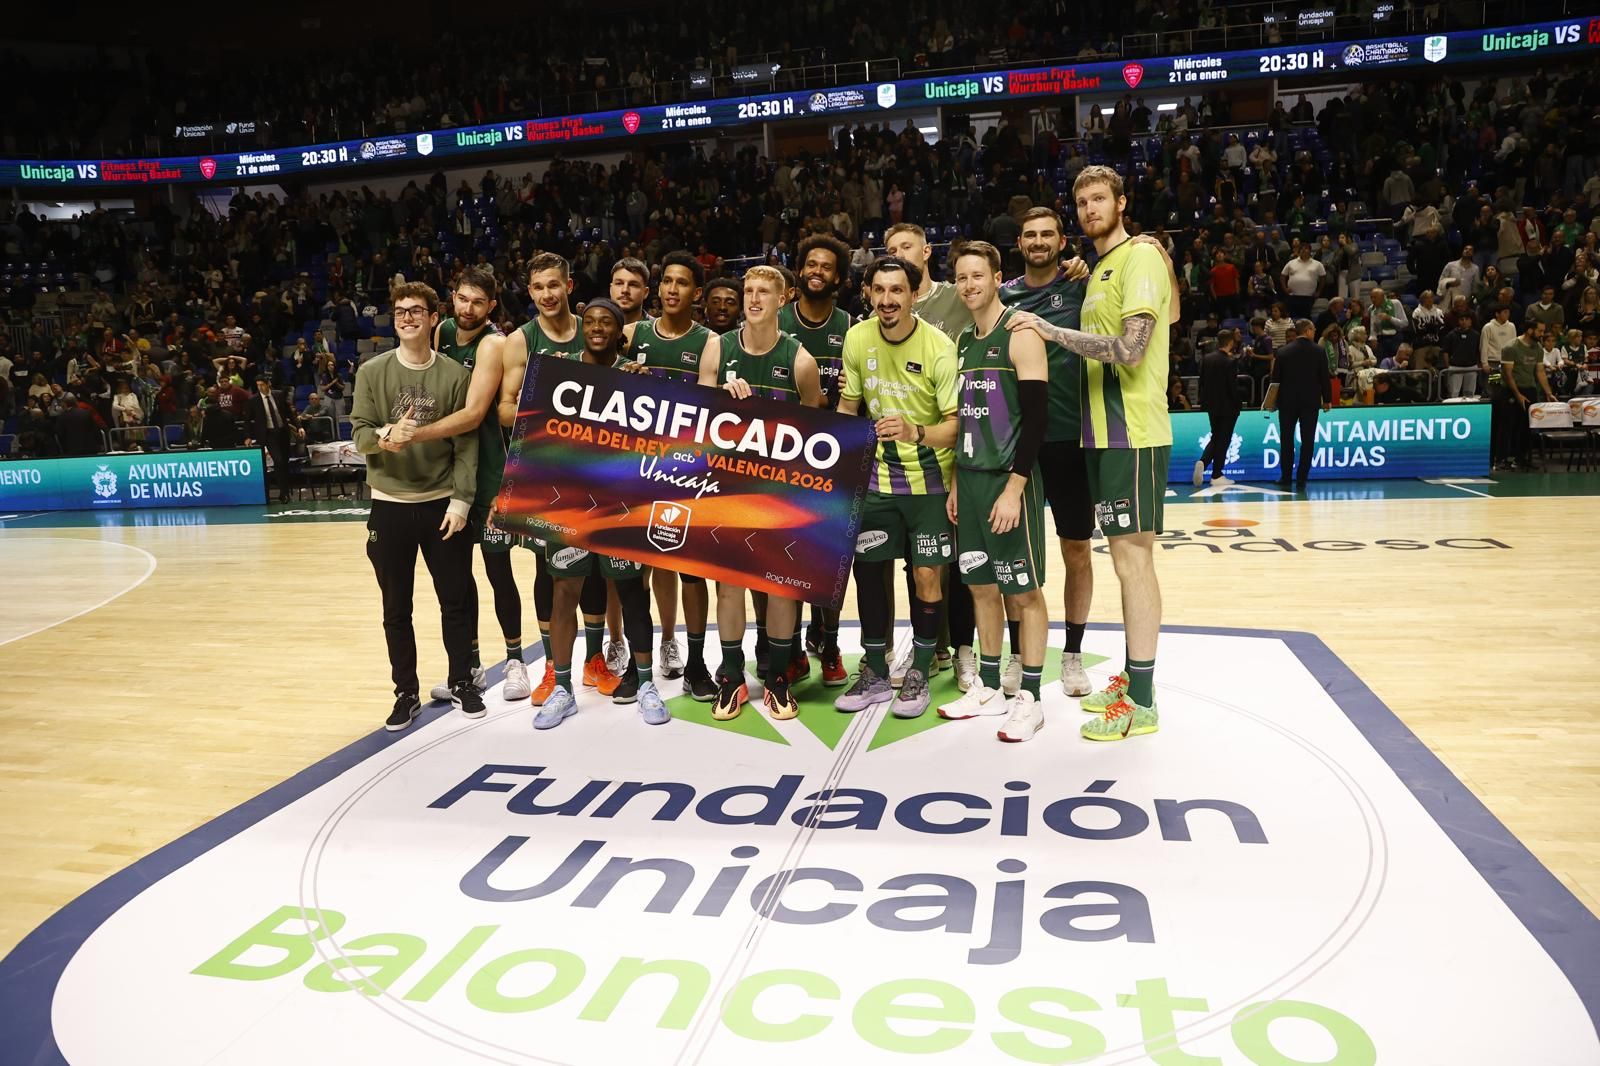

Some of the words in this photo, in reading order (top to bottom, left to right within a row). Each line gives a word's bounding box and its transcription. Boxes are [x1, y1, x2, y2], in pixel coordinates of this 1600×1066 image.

[1482, 29, 1549, 51] Unicaja
[1555, 24, 1581, 44] VS
[1366, 47, 1408, 55] CHAMPIONS
[1174, 57, 1222, 70] Miércoles
[1260, 53, 1308, 72] 20:30
[1313, 50, 1324, 68] H
[1009, 71, 1048, 83] Fitness
[1050, 68, 1076, 79] First
[1063, 76, 1101, 90] Basket
[1169, 72, 1181, 83] 21
[1185, 71, 1197, 81] de
[1199, 70, 1227, 80] enero
[925, 80, 979, 99] Unicaja
[983, 76, 1004, 94] VS
[665, 105, 706, 117] Miércoles
[738, 100, 780, 118] 20:30
[784, 97, 794, 114] H
[527, 121, 560, 131] Fitness
[562, 118, 583, 127] First
[572, 125, 604, 137] Basket
[662, 119, 673, 129] 21
[676, 117, 686, 127] de
[687, 116, 712, 126] enero
[457, 129, 502, 146] Unicaja
[505, 126, 523, 141] VS
[101, 161, 137, 171] Fitness
[139, 160, 160, 170] First
[239, 153, 276, 164] Miércoles
[302, 149, 337, 166] 20:30
[339, 146, 348, 161] H
[20, 164, 74, 182] Unicaja
[77, 164, 98, 179] VS
[150, 169, 182, 179] Basket
[236, 166, 247, 175] 21
[248, 164, 258, 174] de
[259, 163, 280, 172] enero
[552, 380, 841, 470] CLASIFICADO
[1262, 417, 1472, 444] ANTAMIENTO
[512, 417, 528, 467] CLASIFICADO
[963, 432, 974, 458] 4
[545, 418, 595, 444] COPA
[597, 429, 630, 450] DEL
[634, 437, 672, 458] REY
[673, 452, 696, 464] acb
[706, 453, 788, 483] VALENCIA
[790, 472, 833, 493] 2026
[1311, 445, 1386, 468] MIJAS
[128, 459, 251, 481] AYUNTAMIENTO
[640, 454, 720, 500] Unicaja
[130, 483, 151, 499] DE
[154, 481, 203, 499] MIJAS
[499, 479, 515, 528] CLASIFICADO
[846, 485, 864, 538] CLASIFICADO
[526, 516, 578, 536] 19-22/Febrero
[654, 523, 681, 534] Fundación
[657, 529, 677, 539] Unicaja
[652, 534, 679, 544] Baloncesto
[917, 544, 938, 557] laga
[610, 558, 631, 570] laga
[785, 576, 812, 590] Arena
[830, 554, 849, 609] CLASIFICADO
[427, 763, 1270, 844] Fundación
[458, 835, 1156, 965] Unicaja
[189, 904, 1376, 1066] Baloncesto
